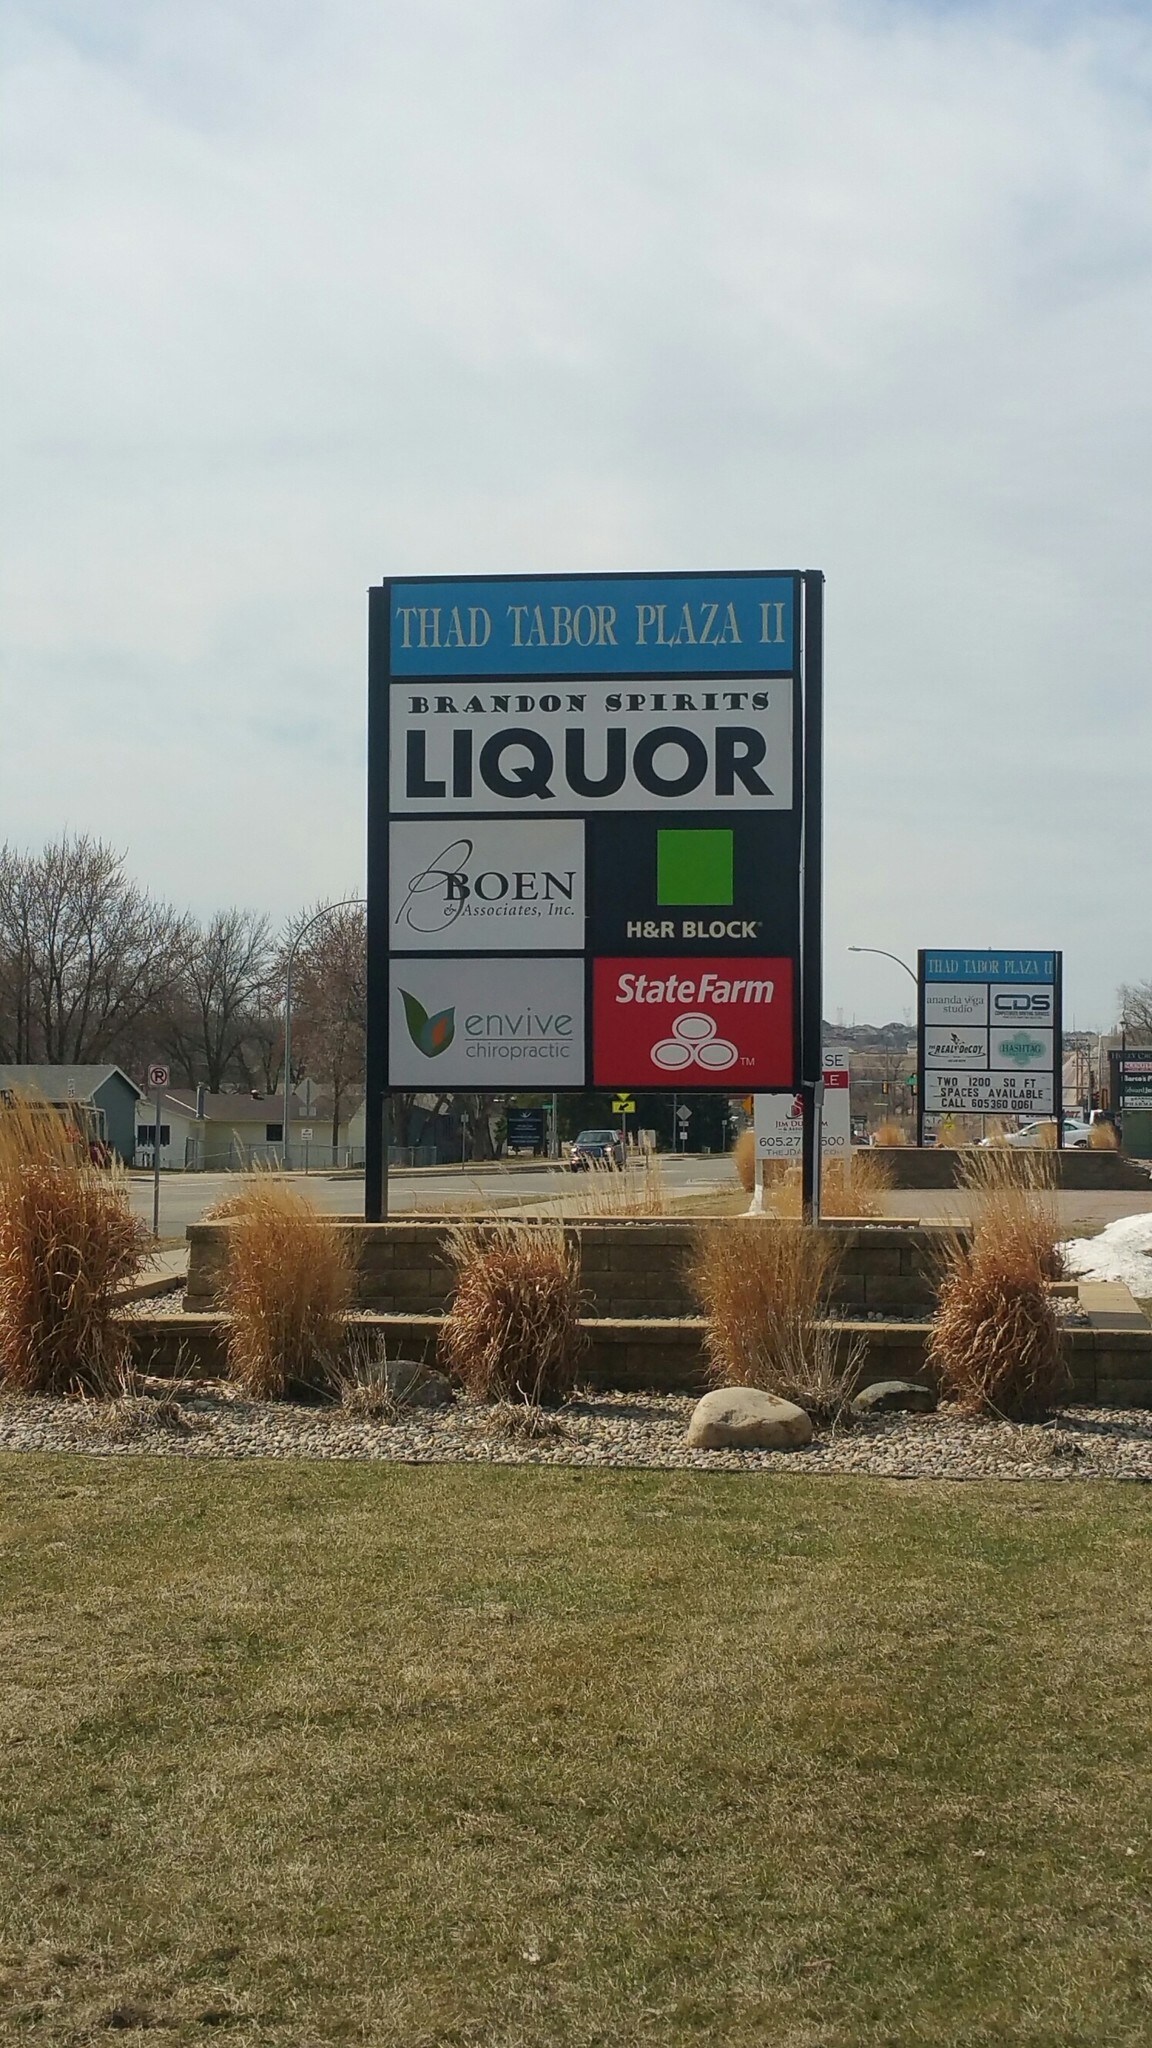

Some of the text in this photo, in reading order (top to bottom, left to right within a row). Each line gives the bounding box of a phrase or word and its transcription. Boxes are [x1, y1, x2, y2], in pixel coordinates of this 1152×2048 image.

[395, 602, 785, 648] THAD TABOR PLAZA II
[408, 692, 769, 714] BRANDON SPIRITS
[406, 726, 775, 799] LIQUOR
[443, 871, 577, 901] BOEN
[443, 902, 575, 917] & Associates, Inc.
[626, 921, 757, 938] H&R BLOCK
[928, 960, 959, 973] THAD
[964, 960, 999, 974] TABOR
[1004, 960, 1040, 974] PLAZA
[927, 995, 962, 1005] ananda
[994, 994, 1050, 1011] CDS
[943, 1004, 973, 1014] studio
[465, 1007, 573, 1036] envive
[466, 1042, 570, 1060] chiropractic
[934, 1045, 955, 1055] REAL
[740, 1057, 756, 1066] TM
[937, 1077, 1036, 1088] TWO 1200 SQ FT
[941, 1087, 1043, 1099] SPACES AVAILABLE
[941, 1098, 966, 1107] CALL
